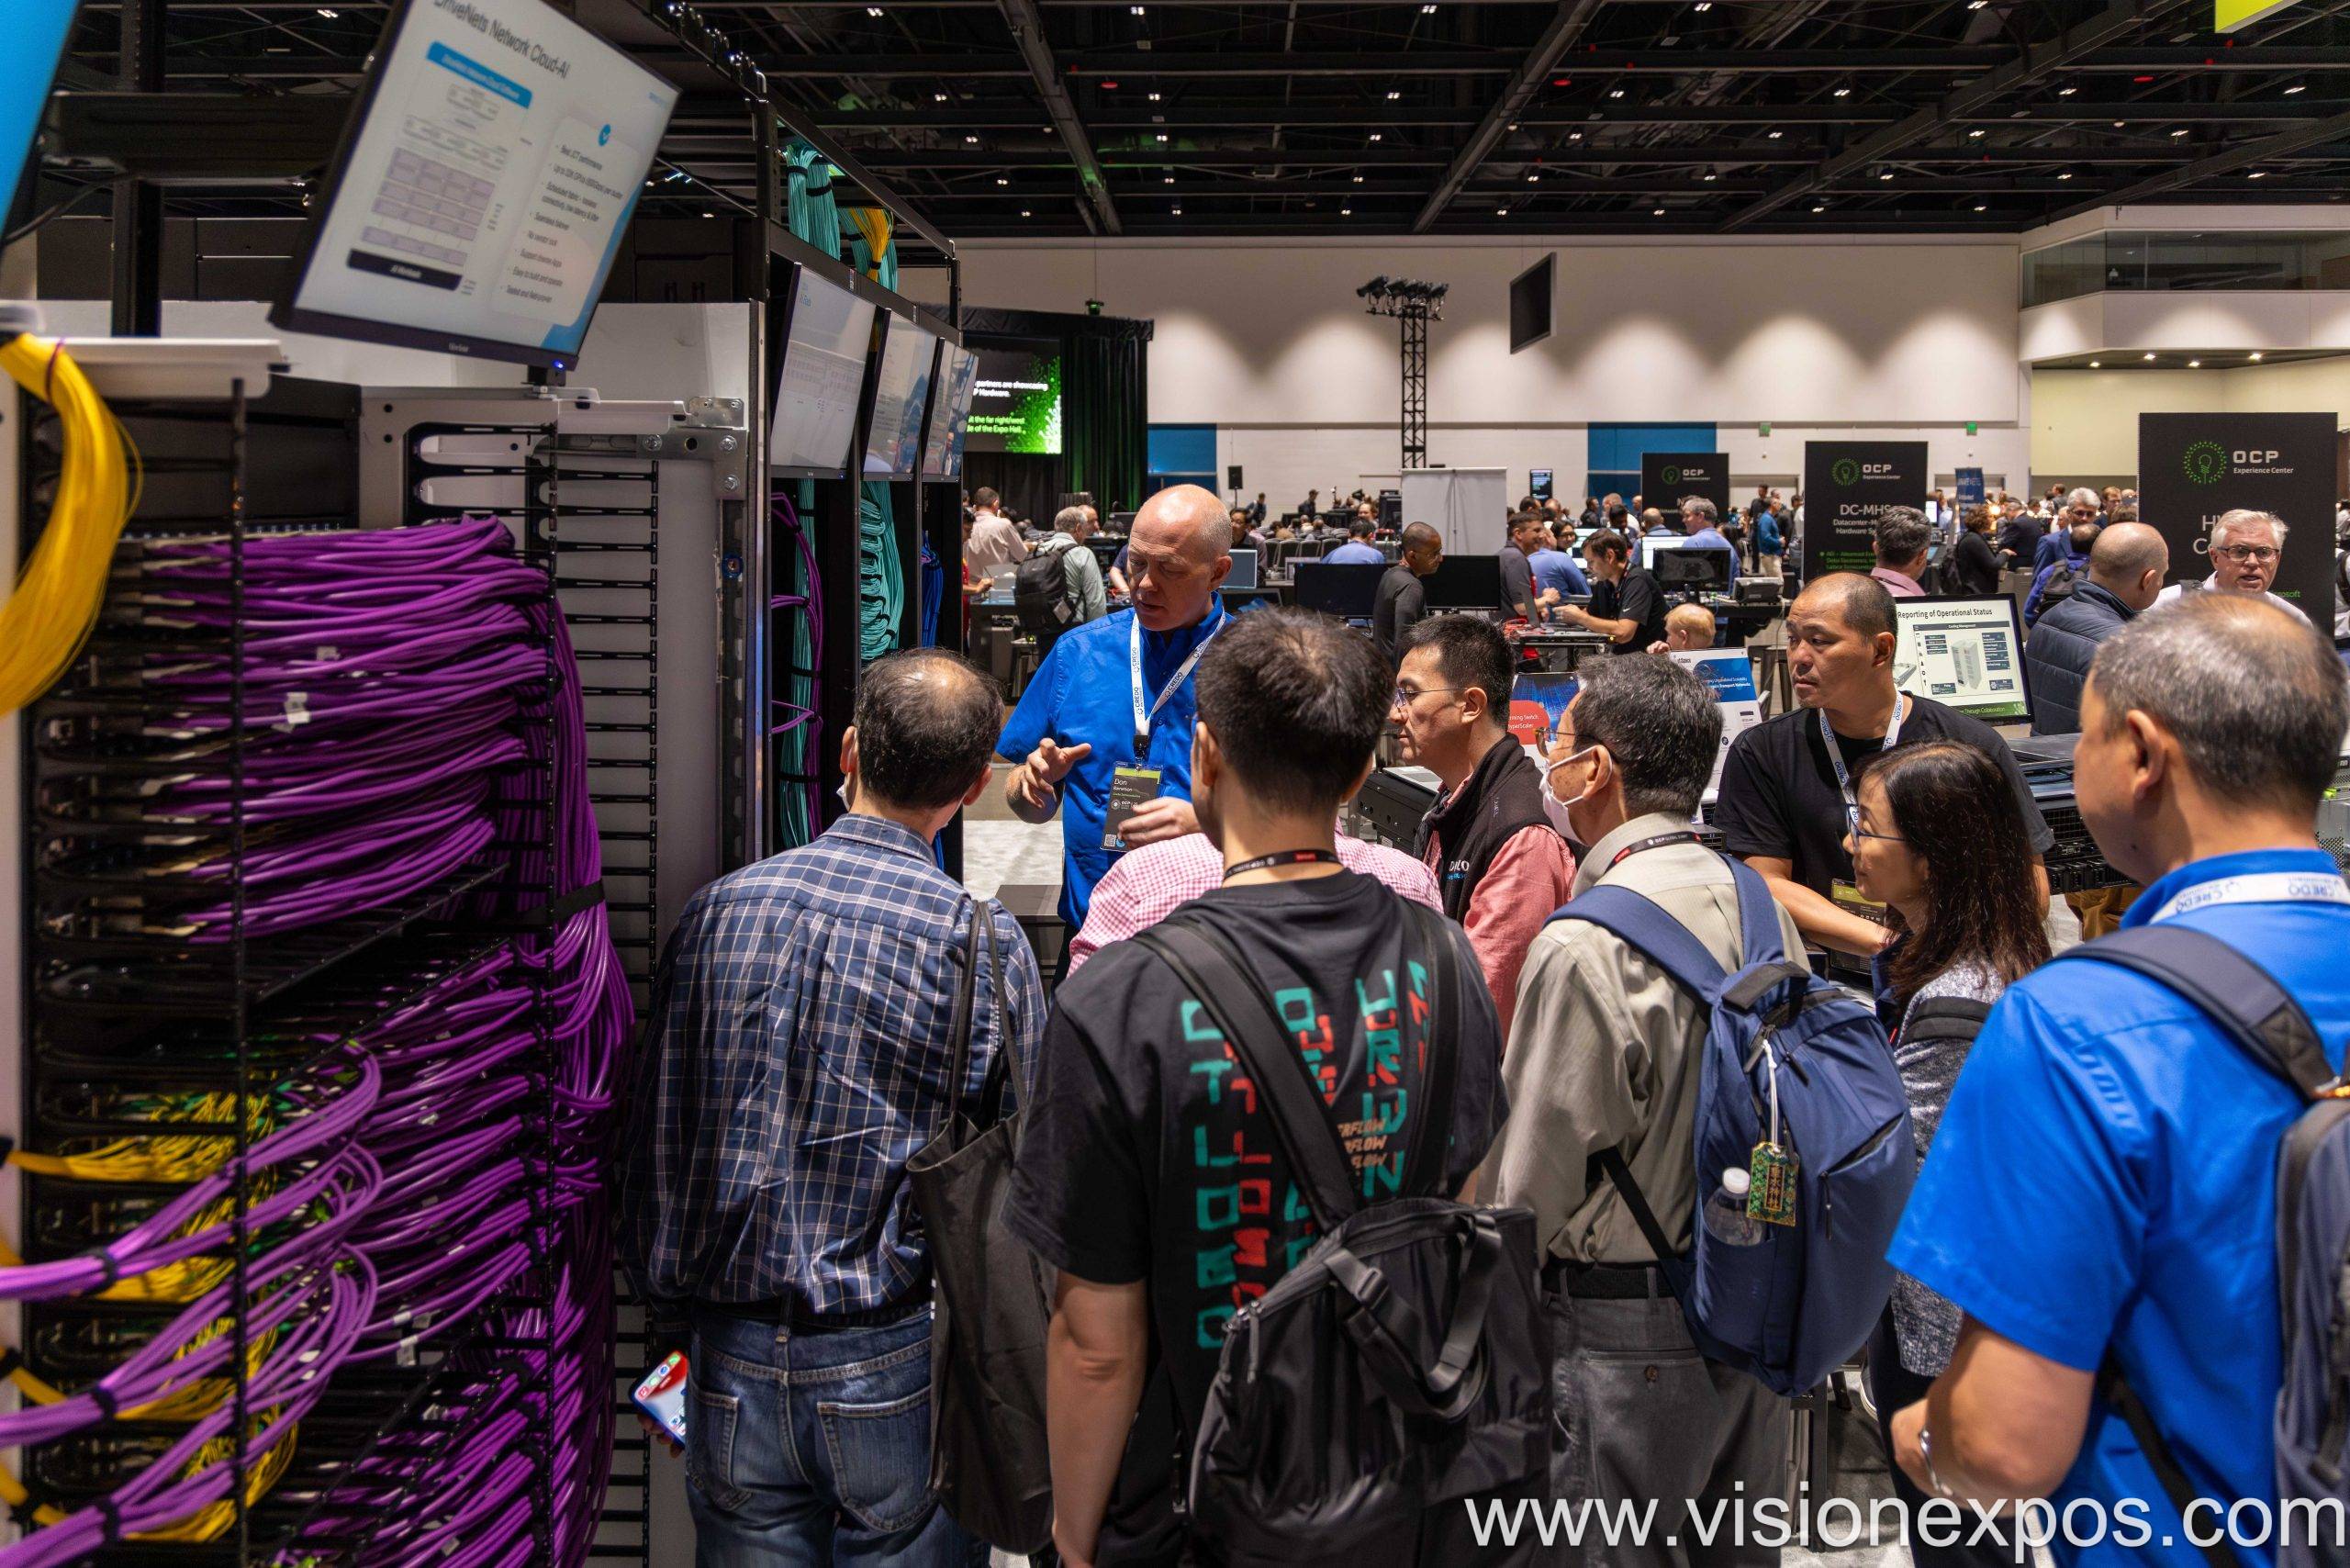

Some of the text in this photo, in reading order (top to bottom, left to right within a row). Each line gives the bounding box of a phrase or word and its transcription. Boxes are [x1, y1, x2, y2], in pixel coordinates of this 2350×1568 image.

[488, 18, 531, 57] Network
[529, 43, 571, 80] Cloud-AI
[974, 415, 986, 424] the
[2232, 450, 2279, 464] OCP
[1682, 468, 1705, 476] OCP
[1862, 464, 1892, 474] OCP
[2233, 466, 2271, 476] Experience
[1836, 527, 1867, 535] Hardware
[1897, 608, 1993, 620] Reporting of Operational Status
[1167, 671, 1183, 691] CREDO
[2175, 889, 2223, 913] CREDO
